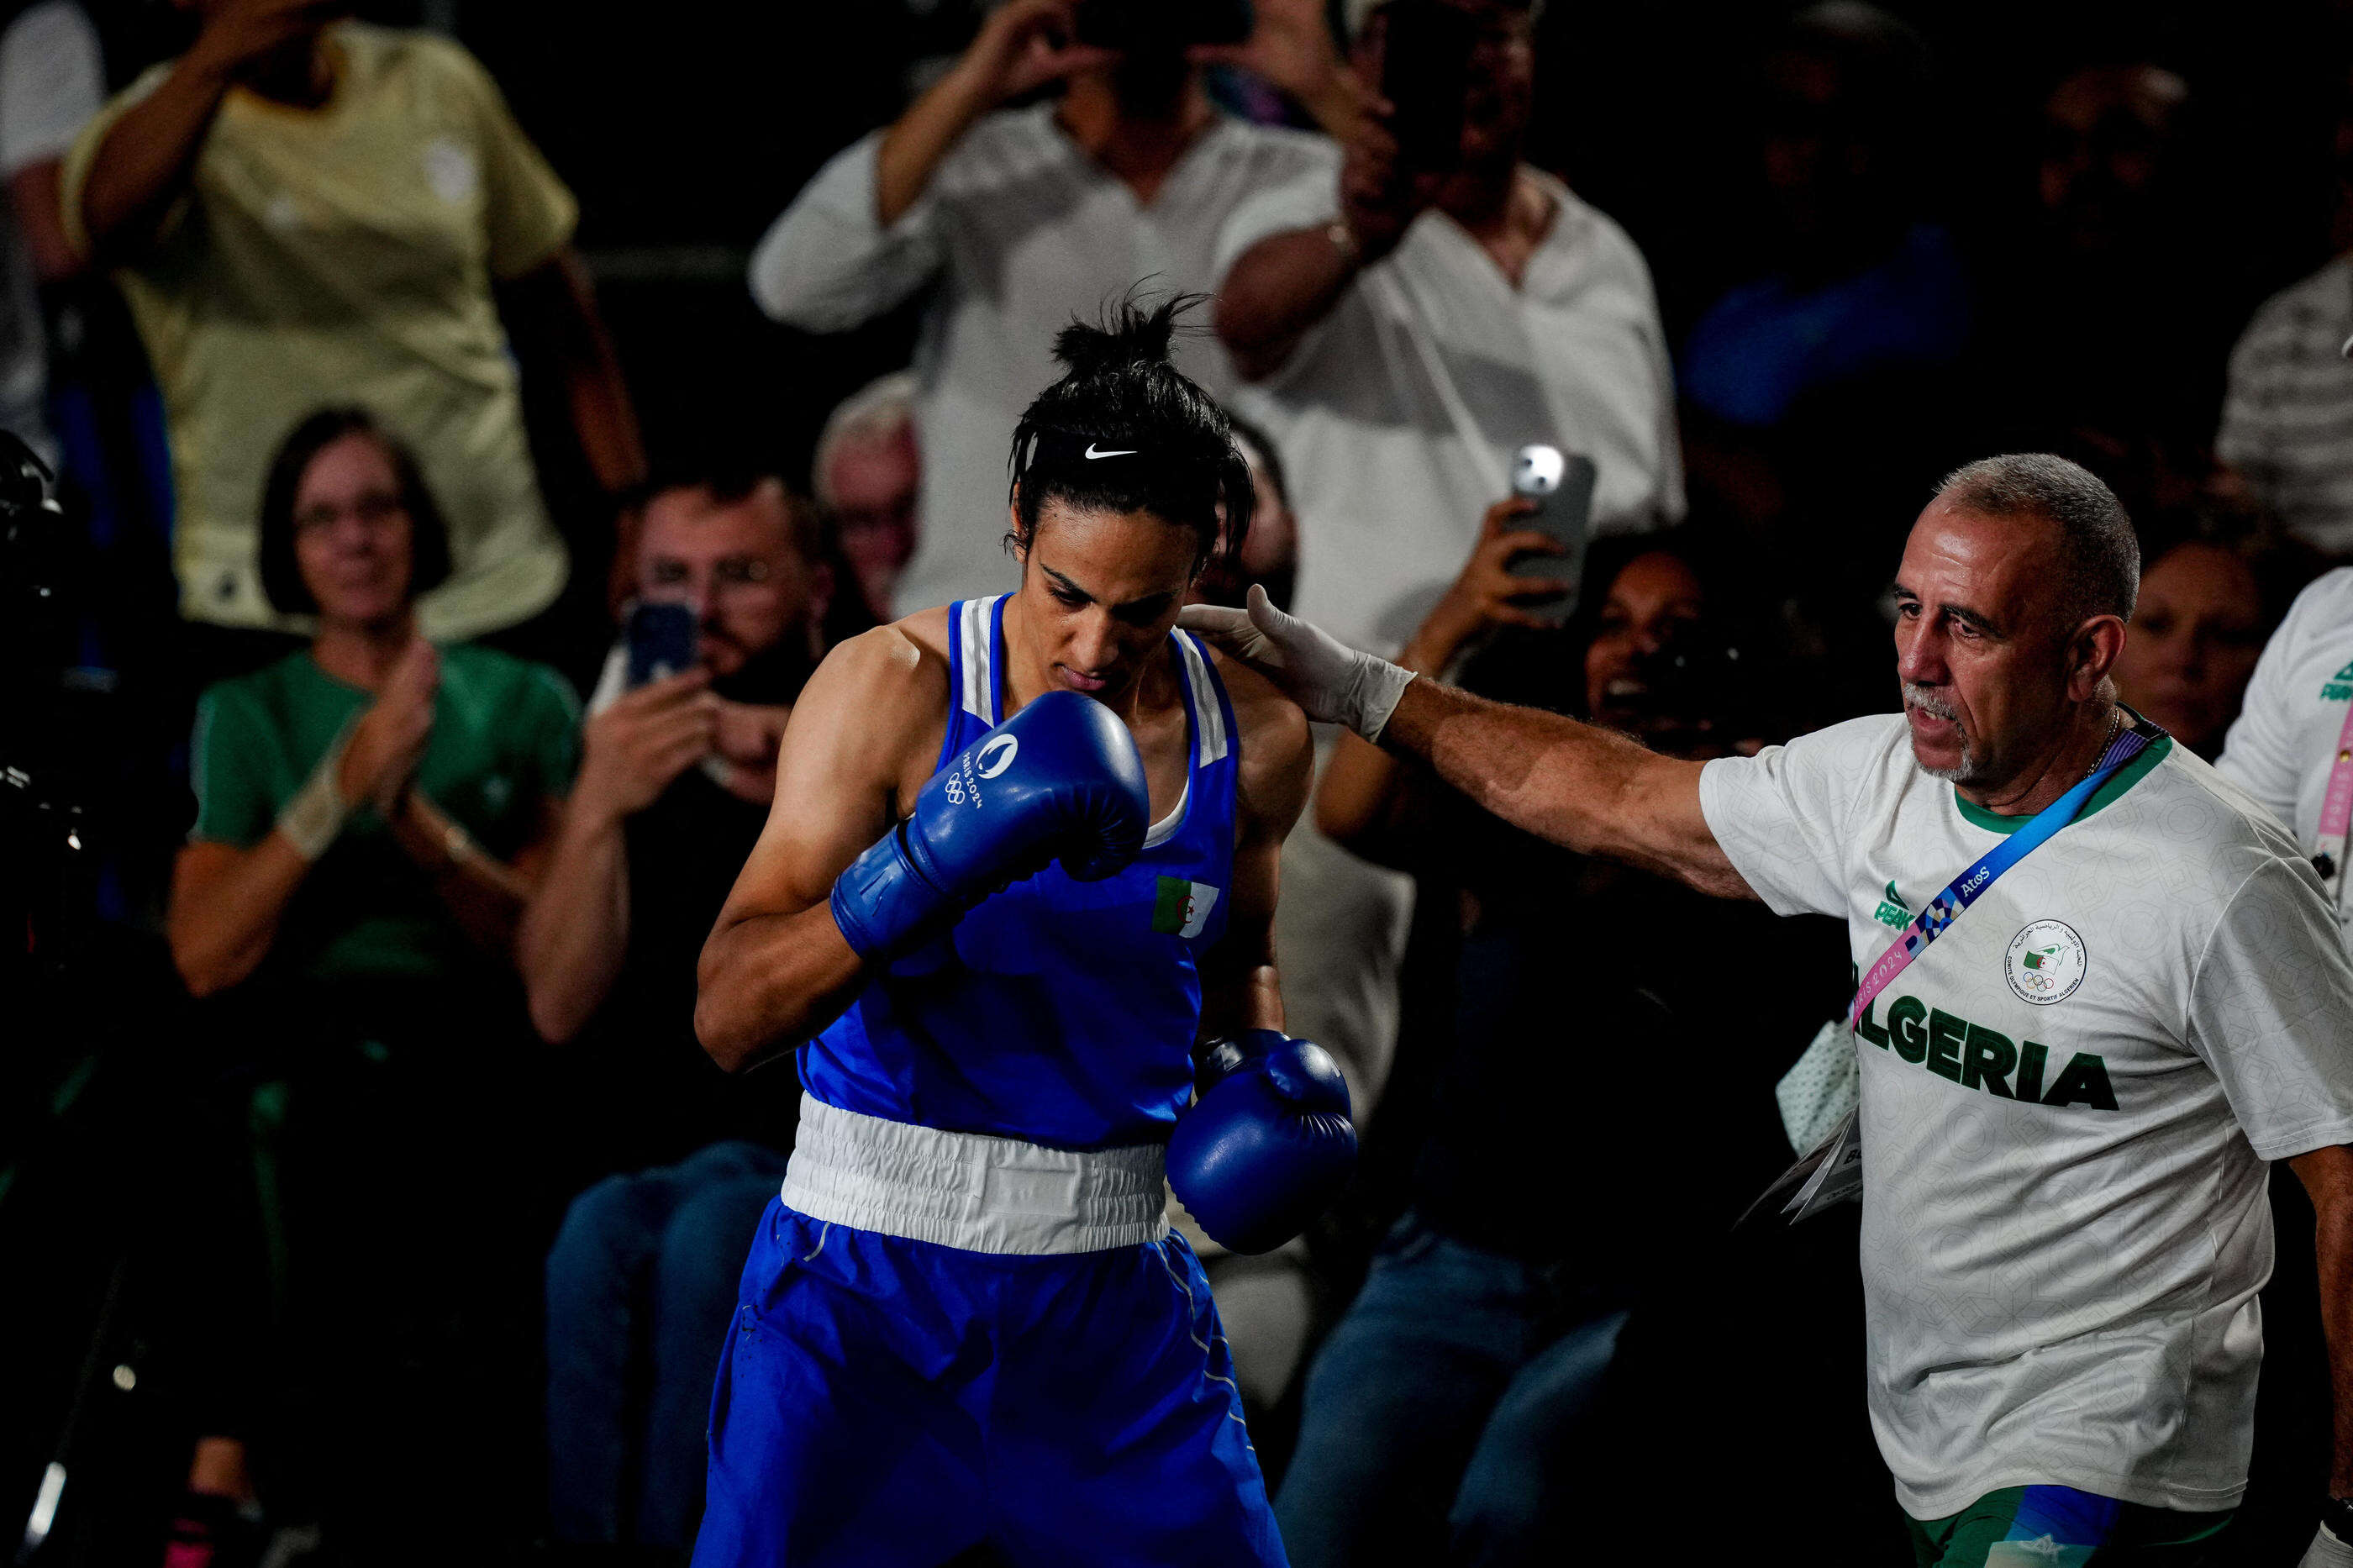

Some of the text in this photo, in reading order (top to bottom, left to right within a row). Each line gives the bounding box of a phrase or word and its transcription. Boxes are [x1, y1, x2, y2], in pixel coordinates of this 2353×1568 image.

[963, 752, 982, 808] PARIS 2024
[1961, 866, 1990, 897] Atos
[1874, 900, 1916, 932] PEAK
[1872, 950, 1903, 986] 2024
[2009, 976, 2029, 998] OLYMPIQUE
[2059, 977, 2080, 998] ALGERIEN
